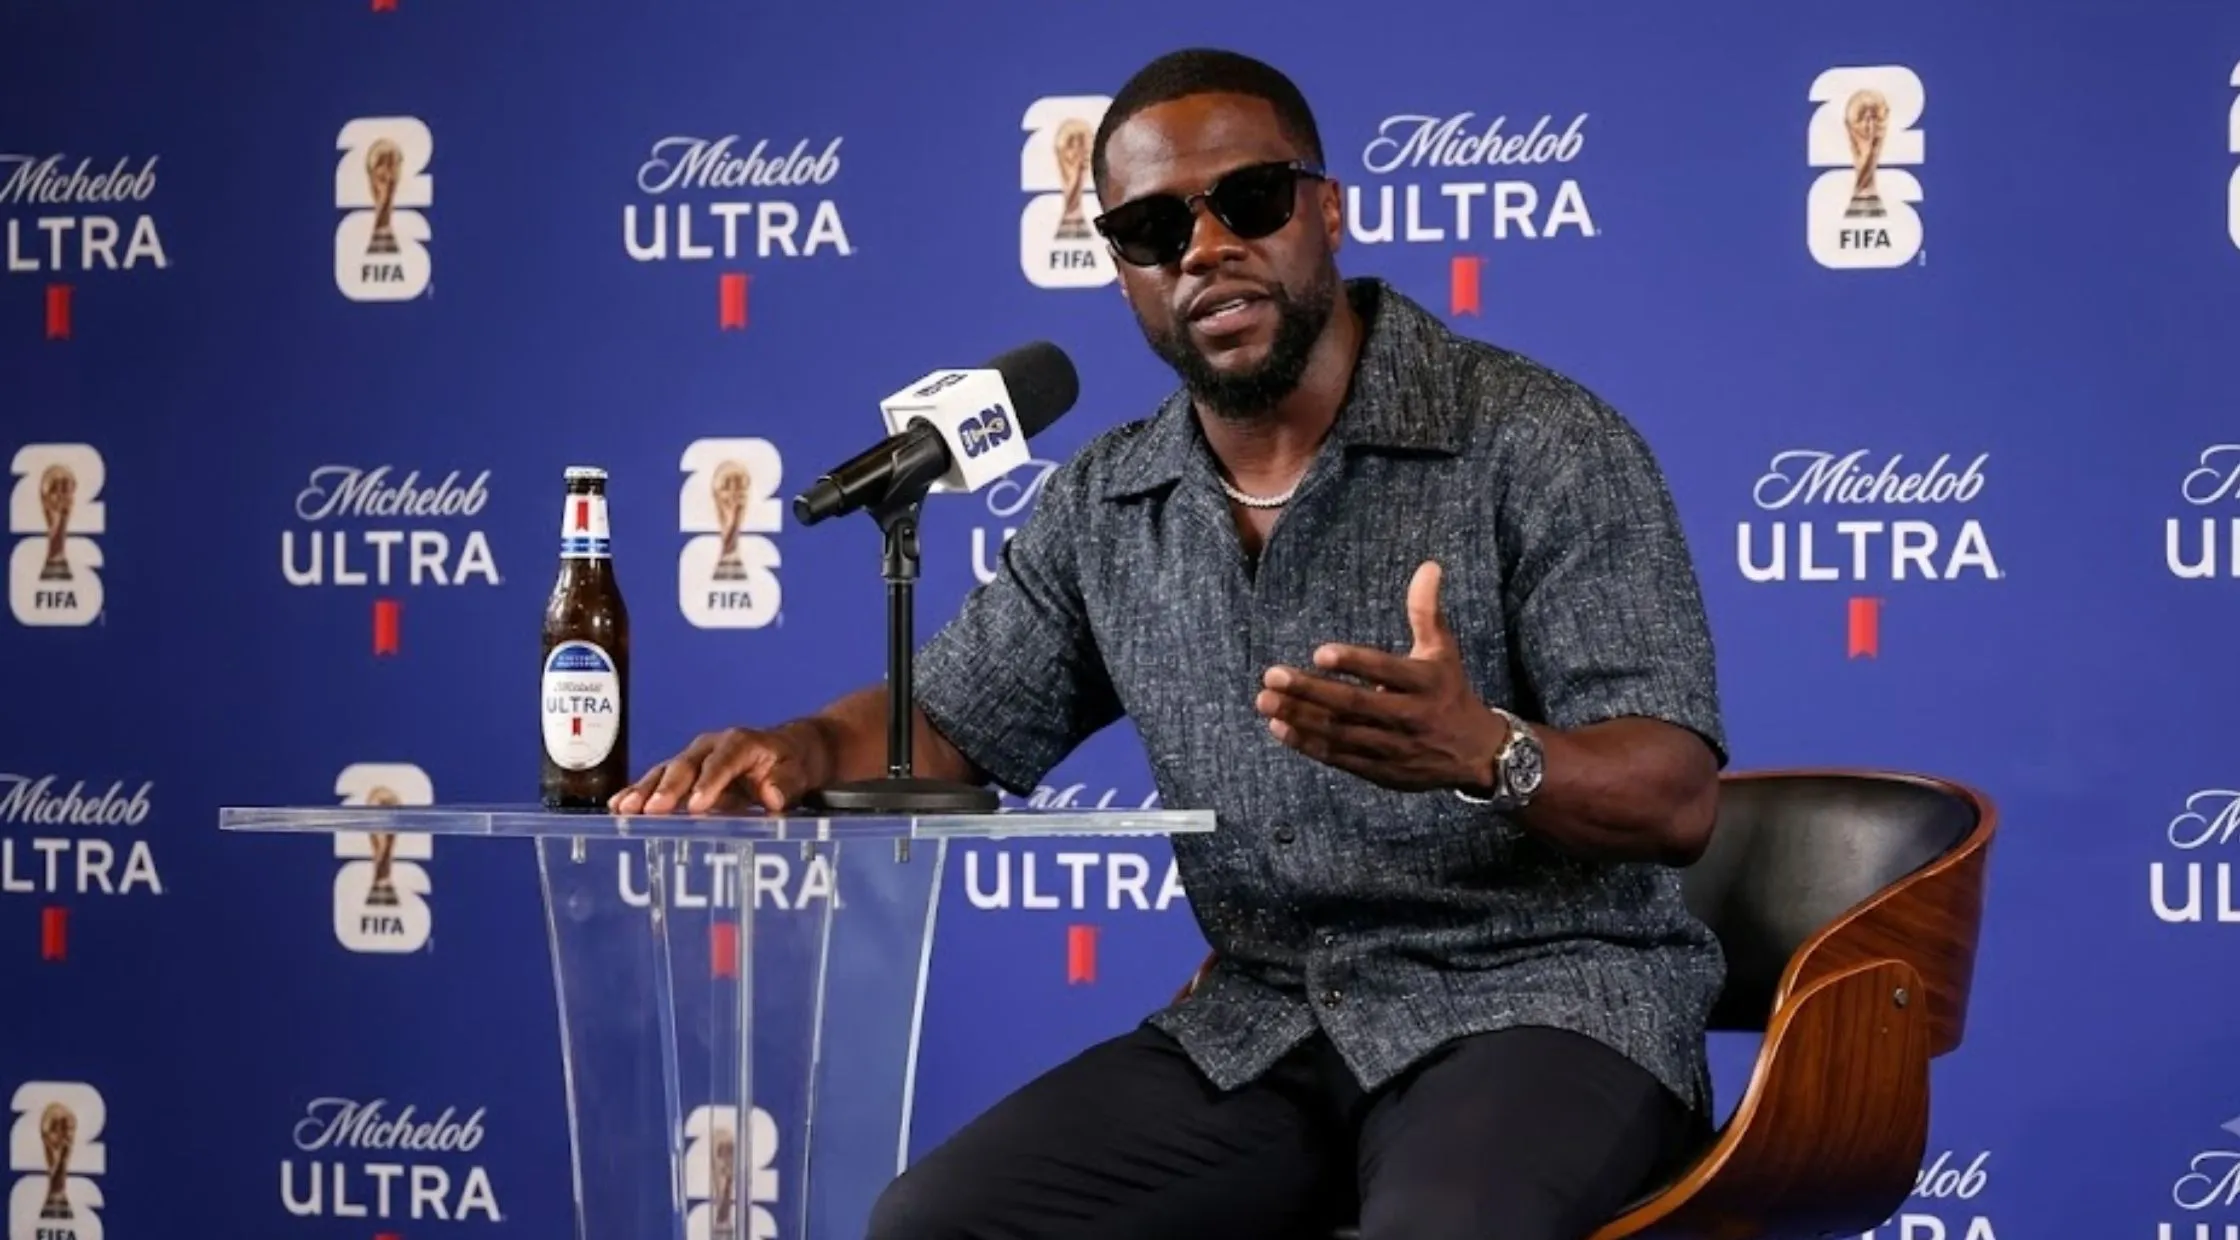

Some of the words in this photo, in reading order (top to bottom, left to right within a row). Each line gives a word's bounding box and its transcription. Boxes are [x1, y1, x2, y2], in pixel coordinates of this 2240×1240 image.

[638, 135, 843, 194] Michelob
[1363, 112, 1588, 173] Michelob
[0, 154, 158, 203] Michelob
[624, 200, 851, 261] ULTRA
[1347, 179, 1595, 244] ULTRA
[1840, 229, 1891, 249] FIFA
[8, 214, 167, 271] LTRA
[1050, 250, 1096, 269] FIFA
[361, 264, 404, 282] FIFA
[296, 466, 491, 520] Michelob
[1753, 449, 1989, 510] Michelob
[282, 530, 500, 586] ULTRA
[1737, 520, 2000, 582] ULTRA
[35, 591, 78, 609] FIFA
[708, 591, 752, 609] FIFA
[546, 696, 613, 713] ULTRA
[0, 774, 152, 825] Michelob
[2, 838, 162, 895] LTRA
[360, 916, 405, 934] FIFA
[295, 1097, 486, 1152] Michelob
[281, 1160, 502, 1222] ULTRA
